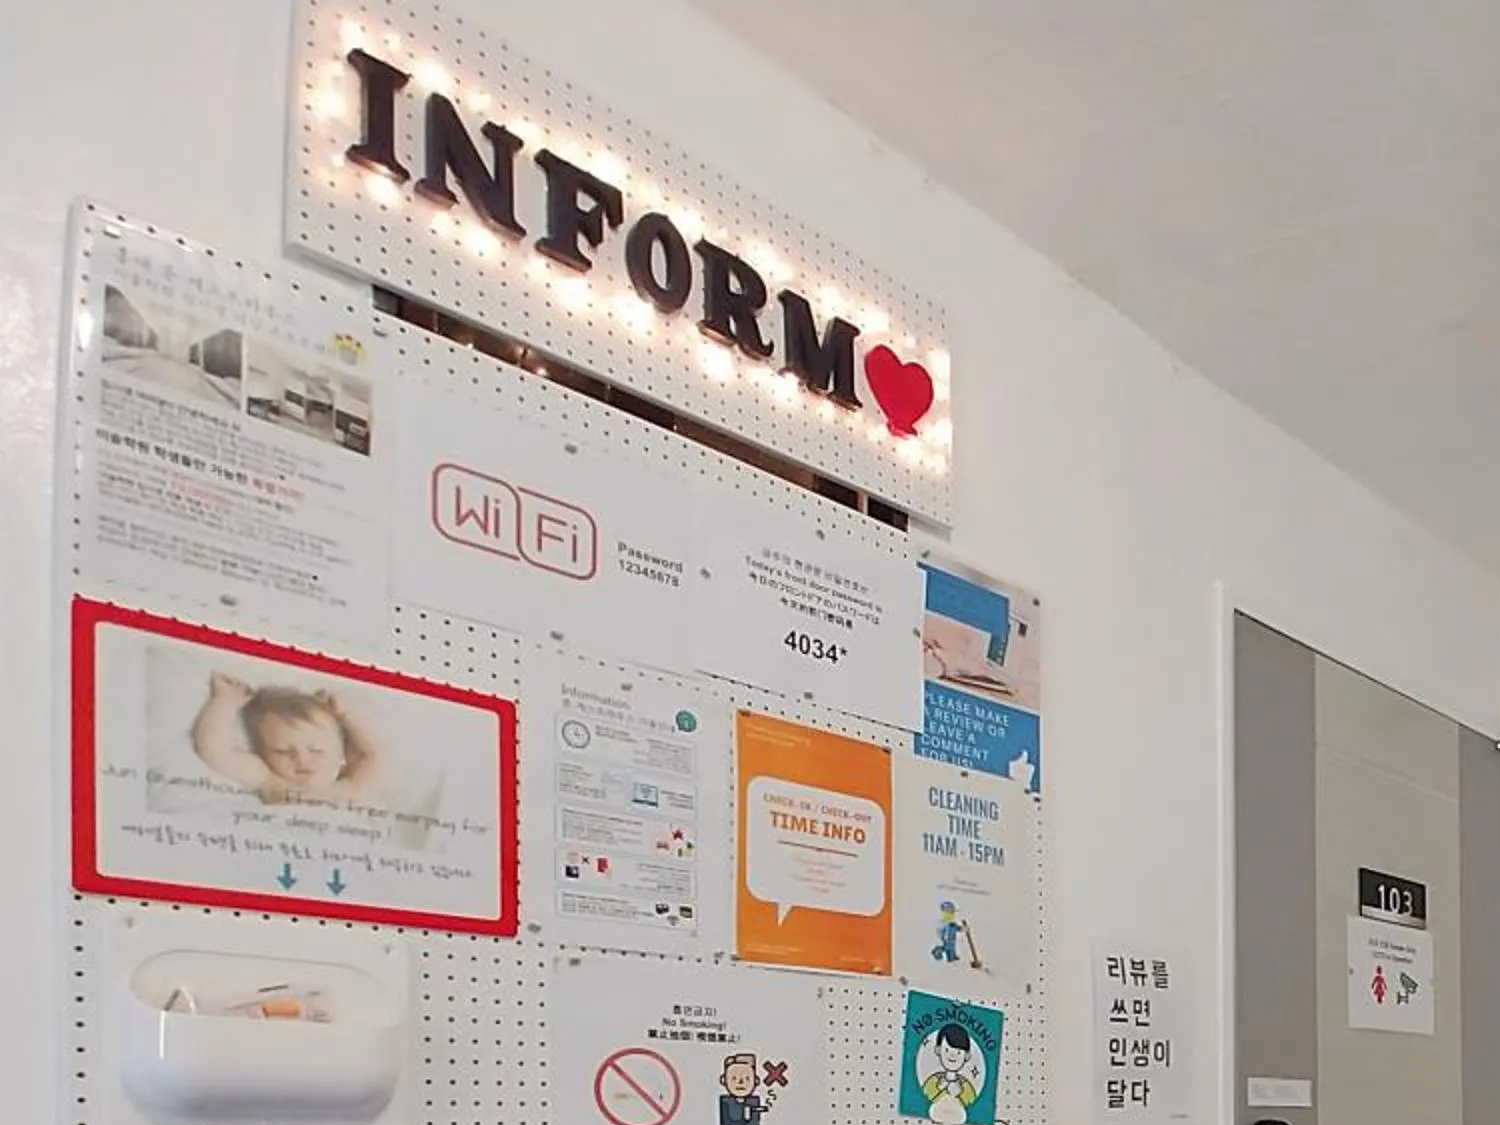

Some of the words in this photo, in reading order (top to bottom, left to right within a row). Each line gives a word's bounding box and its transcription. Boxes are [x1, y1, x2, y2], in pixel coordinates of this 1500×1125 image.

[346, 47, 862, 410] INFORM
[617, 541, 683, 572] Password
[618, 559, 680, 587] 12345678
[924, 721, 966, 741] EAVE
[921, 734, 989, 761] COMMENT
[929, 786, 999, 821] CLEANING
[770, 810, 818, 836] TIME
[822, 821, 866, 845] INFO
[948, 814, 981, 840] TIME
[923, 832, 957, 857] 11AM
[969, 841, 1005, 867] 15PM
[1378, 884, 1413, 915] 103
[1106, 957, 1168, 989] 리뷰를
[662, 1017, 678, 1027] No
[912, 1004, 933, 1036] NO
[935, 997, 997, 1052] SMOKING
[1109, 999, 1150, 1027] 쓰면
[1109, 1038, 1170, 1067] 인생이
[1107, 1079, 1150, 1108] 달다
